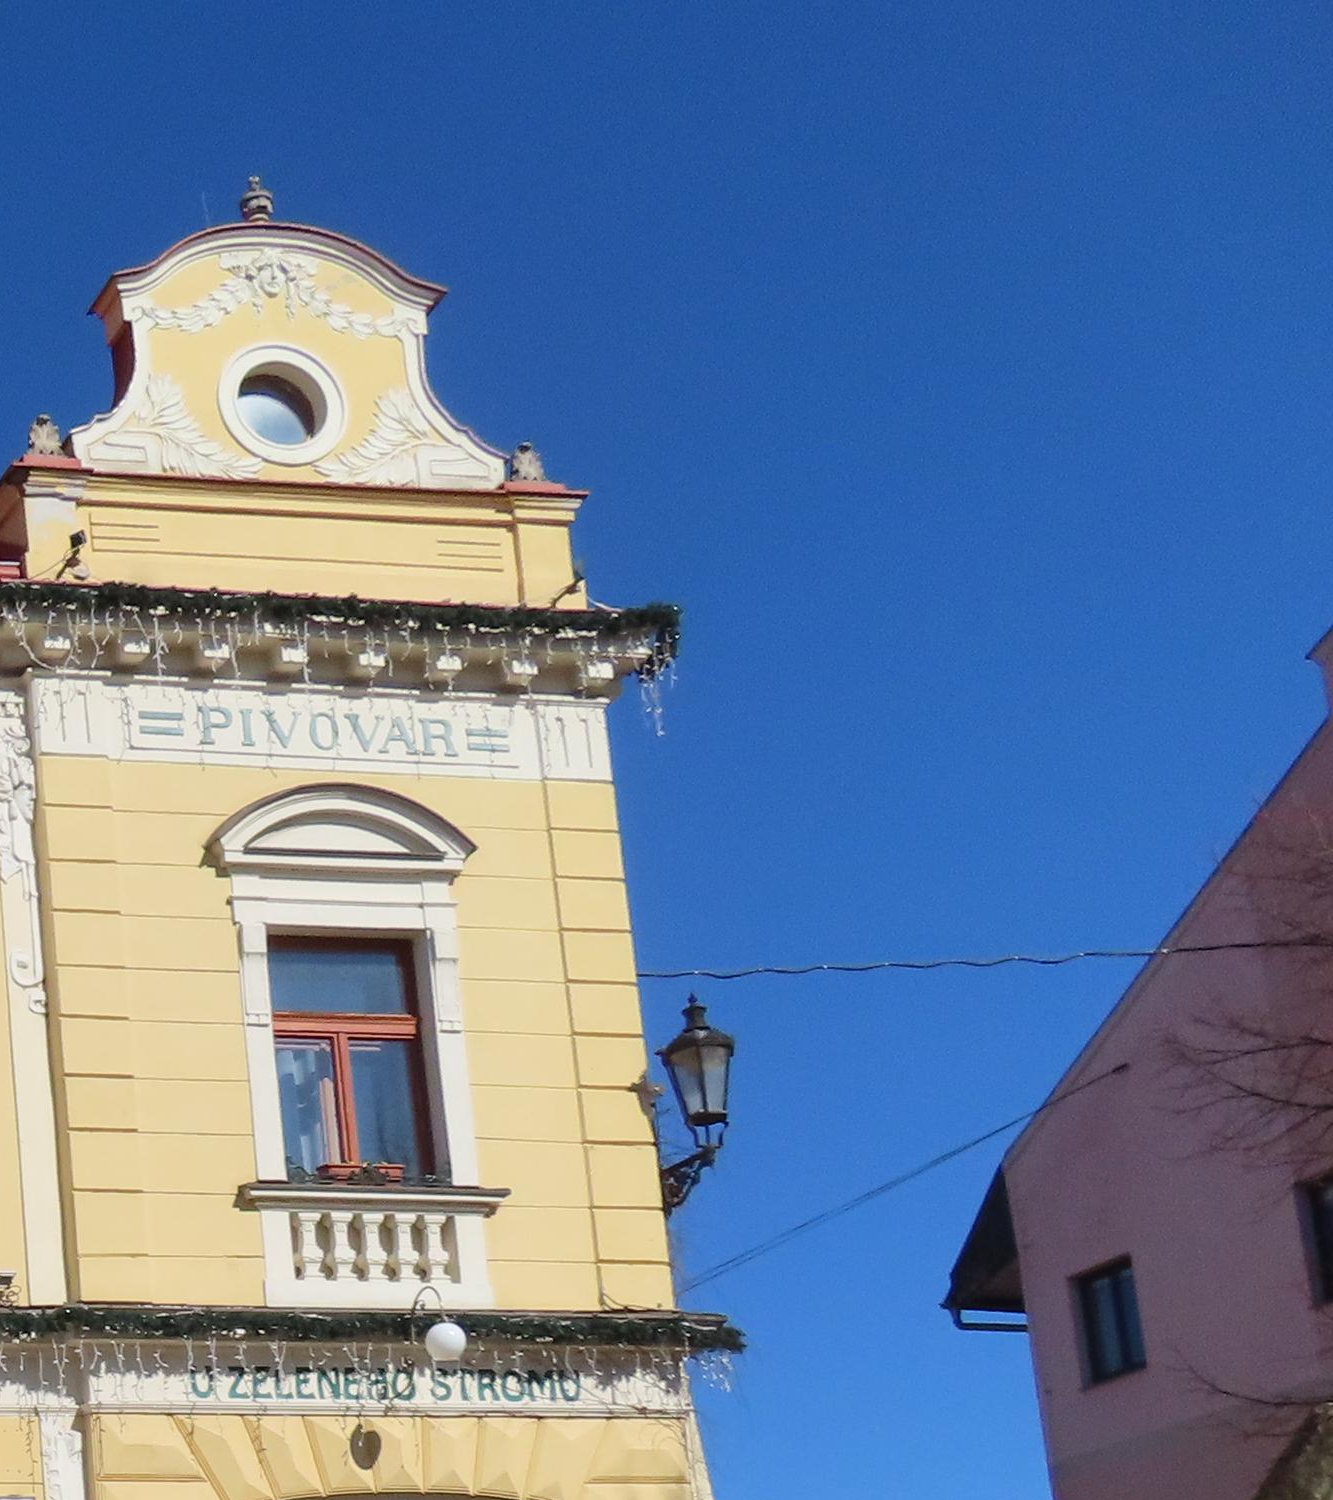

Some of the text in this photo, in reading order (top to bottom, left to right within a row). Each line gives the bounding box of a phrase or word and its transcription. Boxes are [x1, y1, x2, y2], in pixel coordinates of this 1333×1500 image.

[198, 704, 459, 758] PIVOVAR
[190, 1366, 215, 1398] U
[431, 1367, 583, 1402] STROMU
